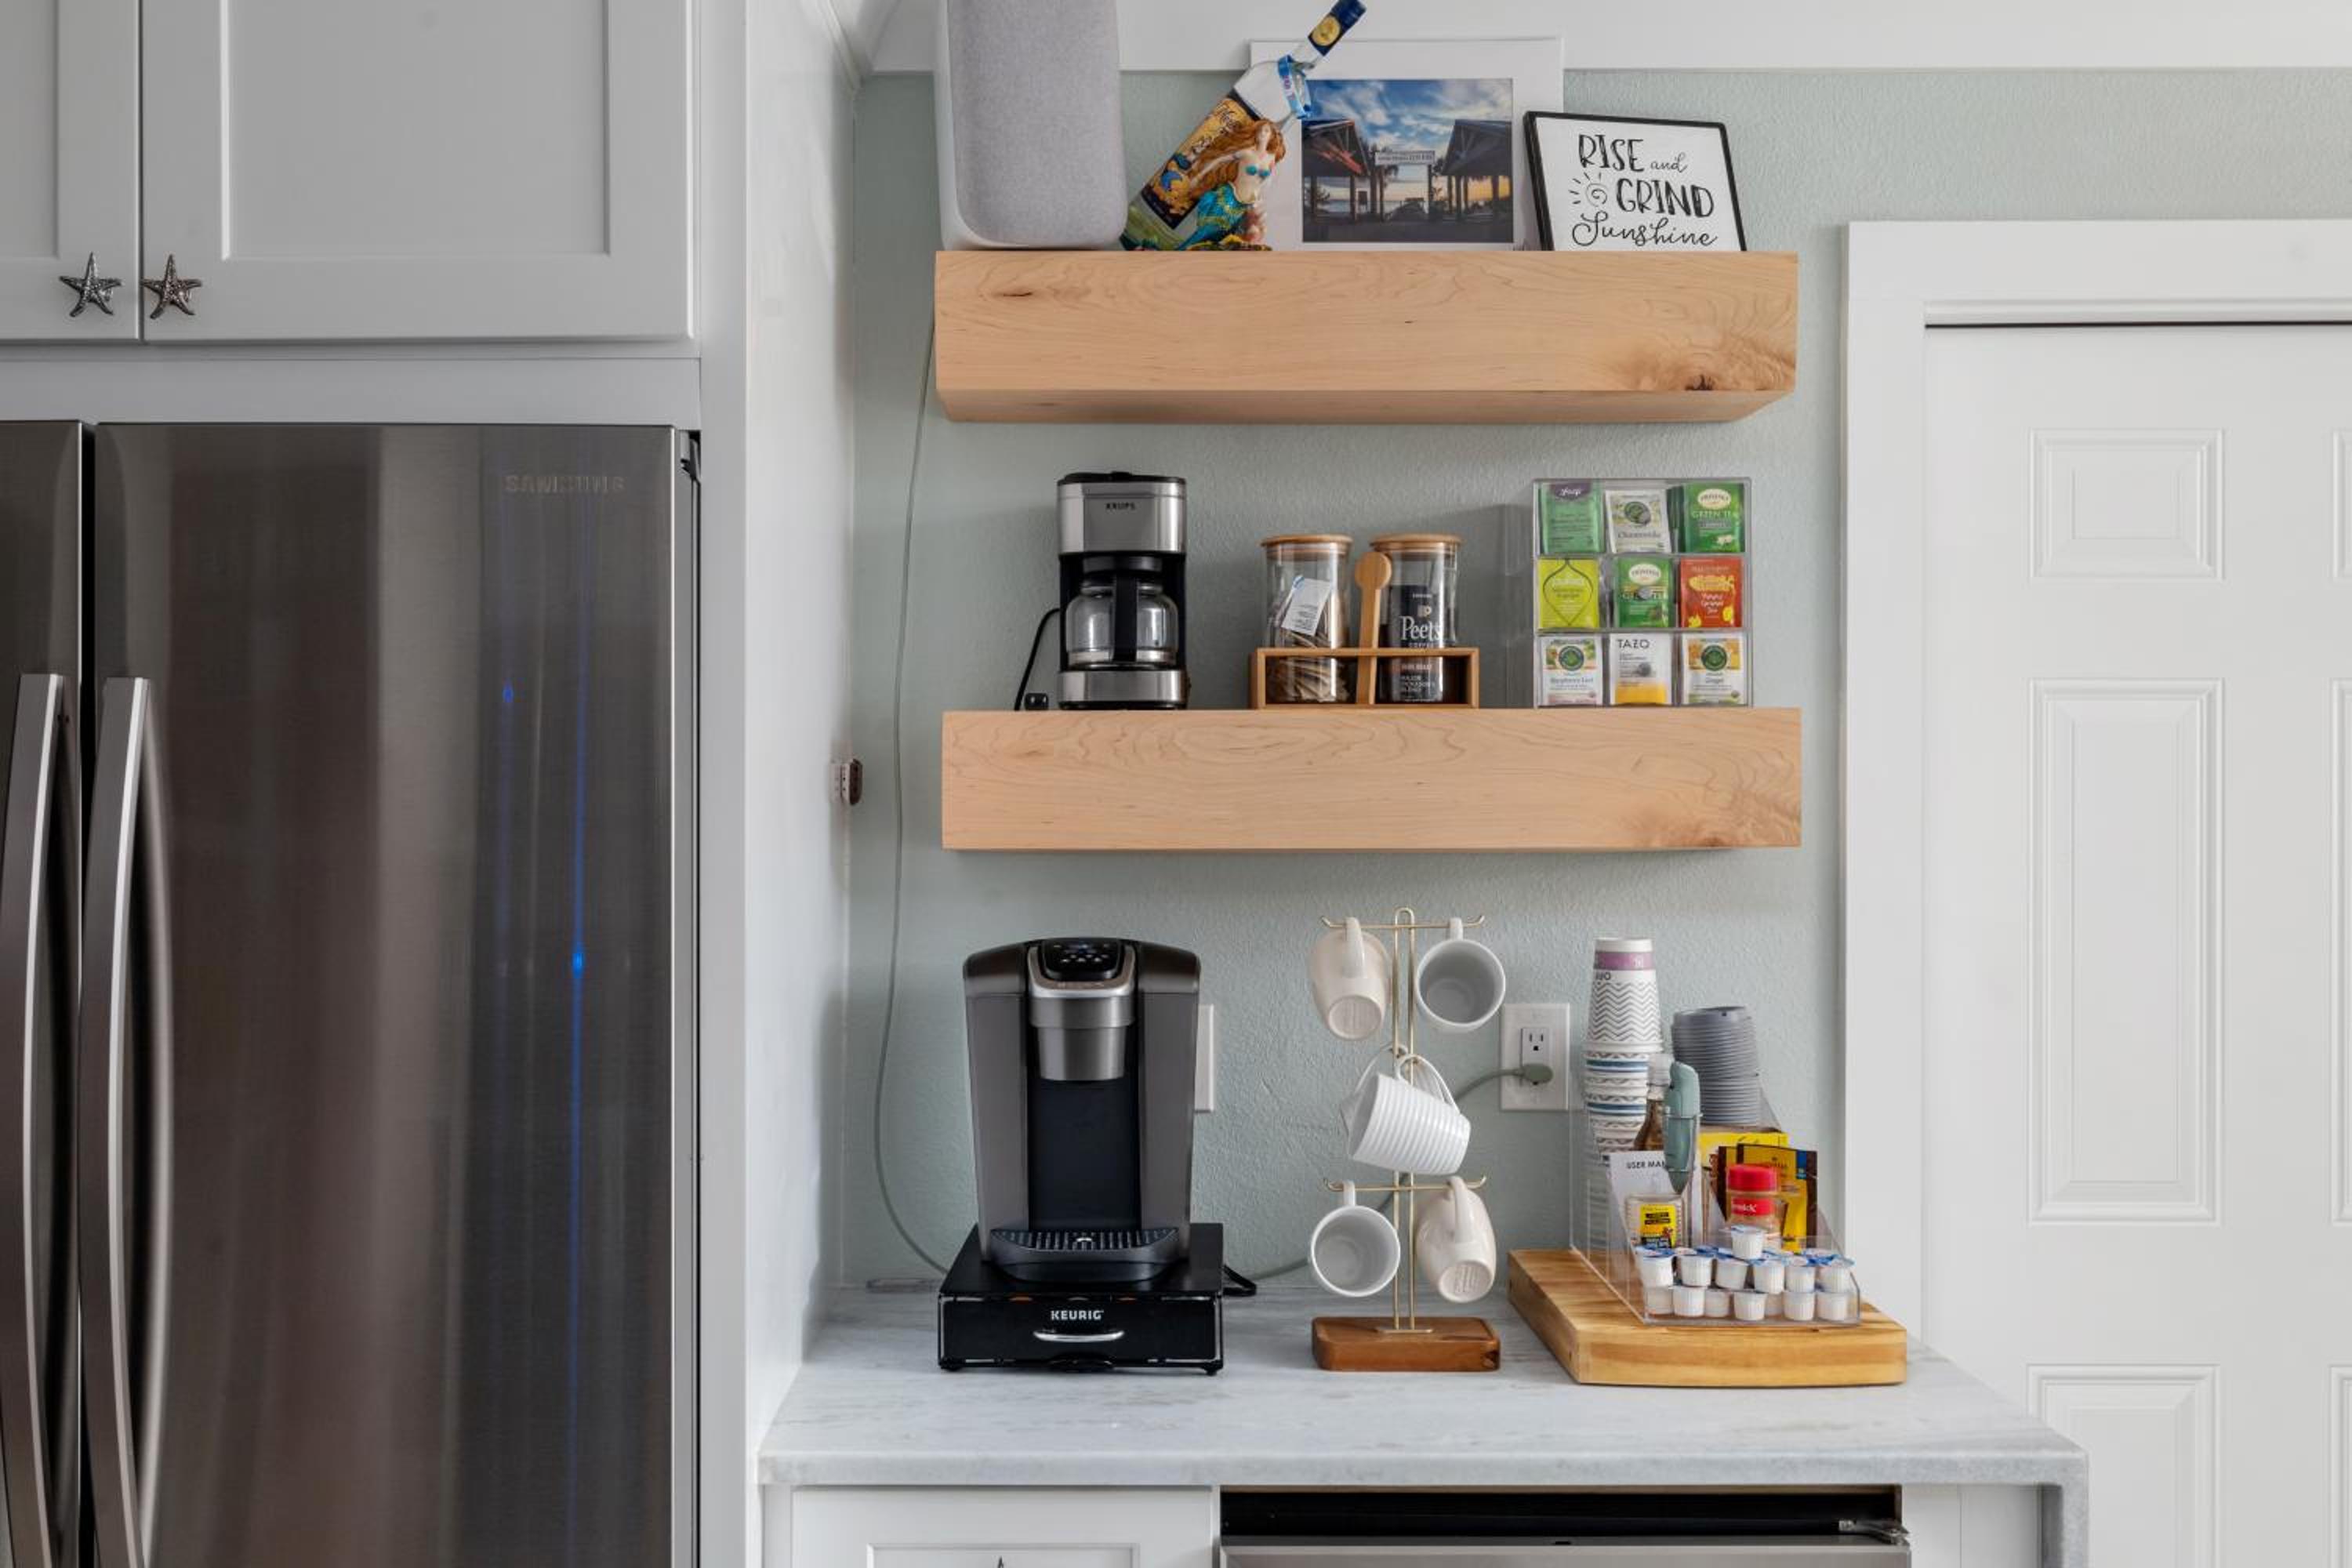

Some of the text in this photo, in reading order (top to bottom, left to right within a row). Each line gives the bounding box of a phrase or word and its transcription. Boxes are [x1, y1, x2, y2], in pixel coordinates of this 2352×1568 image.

[1578, 134, 1688, 172] RISE and
[1616, 177, 1715, 218] GRIND
[1572, 210, 1718, 246] Sunshine
[503, 475, 627, 493] SAMSUNG
[1617, 638, 1650, 649] TAZO
[1626, 1160, 1646, 1169] USER
[1051, 1310, 1102, 1321] KEURIG
